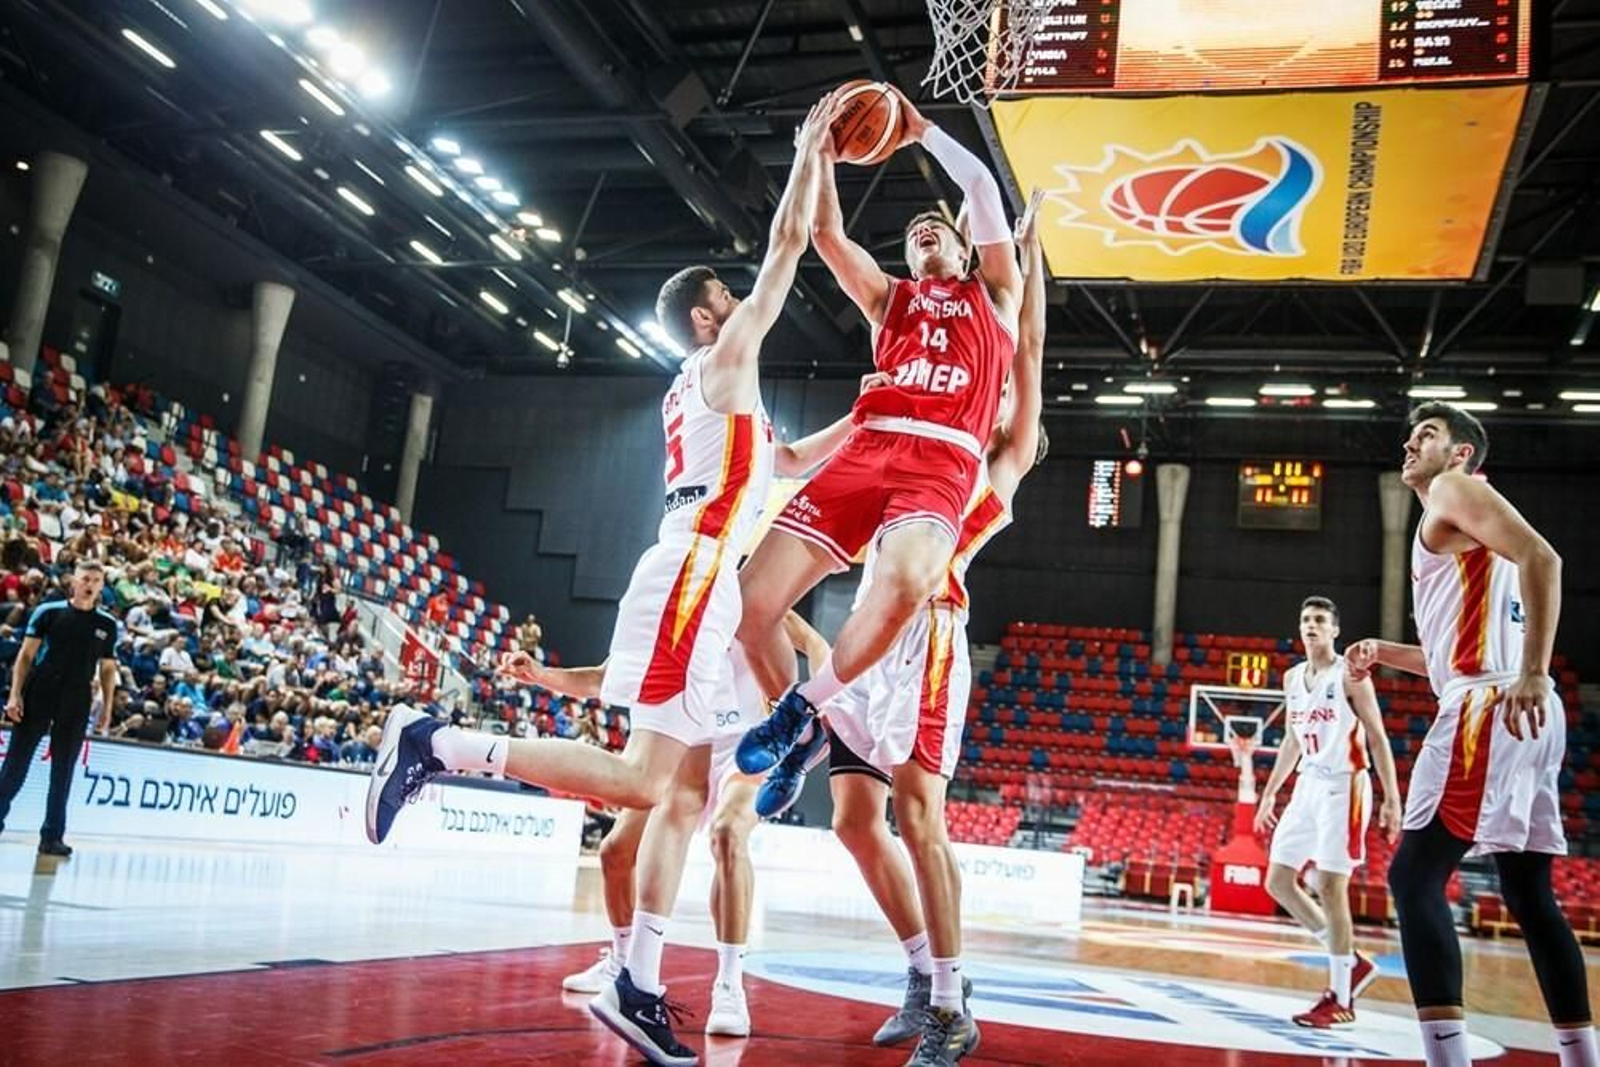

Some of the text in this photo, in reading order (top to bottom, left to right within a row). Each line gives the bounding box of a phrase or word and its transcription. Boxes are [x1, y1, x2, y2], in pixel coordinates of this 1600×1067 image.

[1348, 101, 1382, 189] CHAMPIONSHIP
[1344, 191, 1372, 239] EUROPEAN
[920, 321, 948, 353] 14
[666, 413, 684, 484] 5
[1304, 733, 1319, 756] 11
[84, 766, 296, 819] פועלים איתכם בכל
[440, 804, 465, 832] בכל
